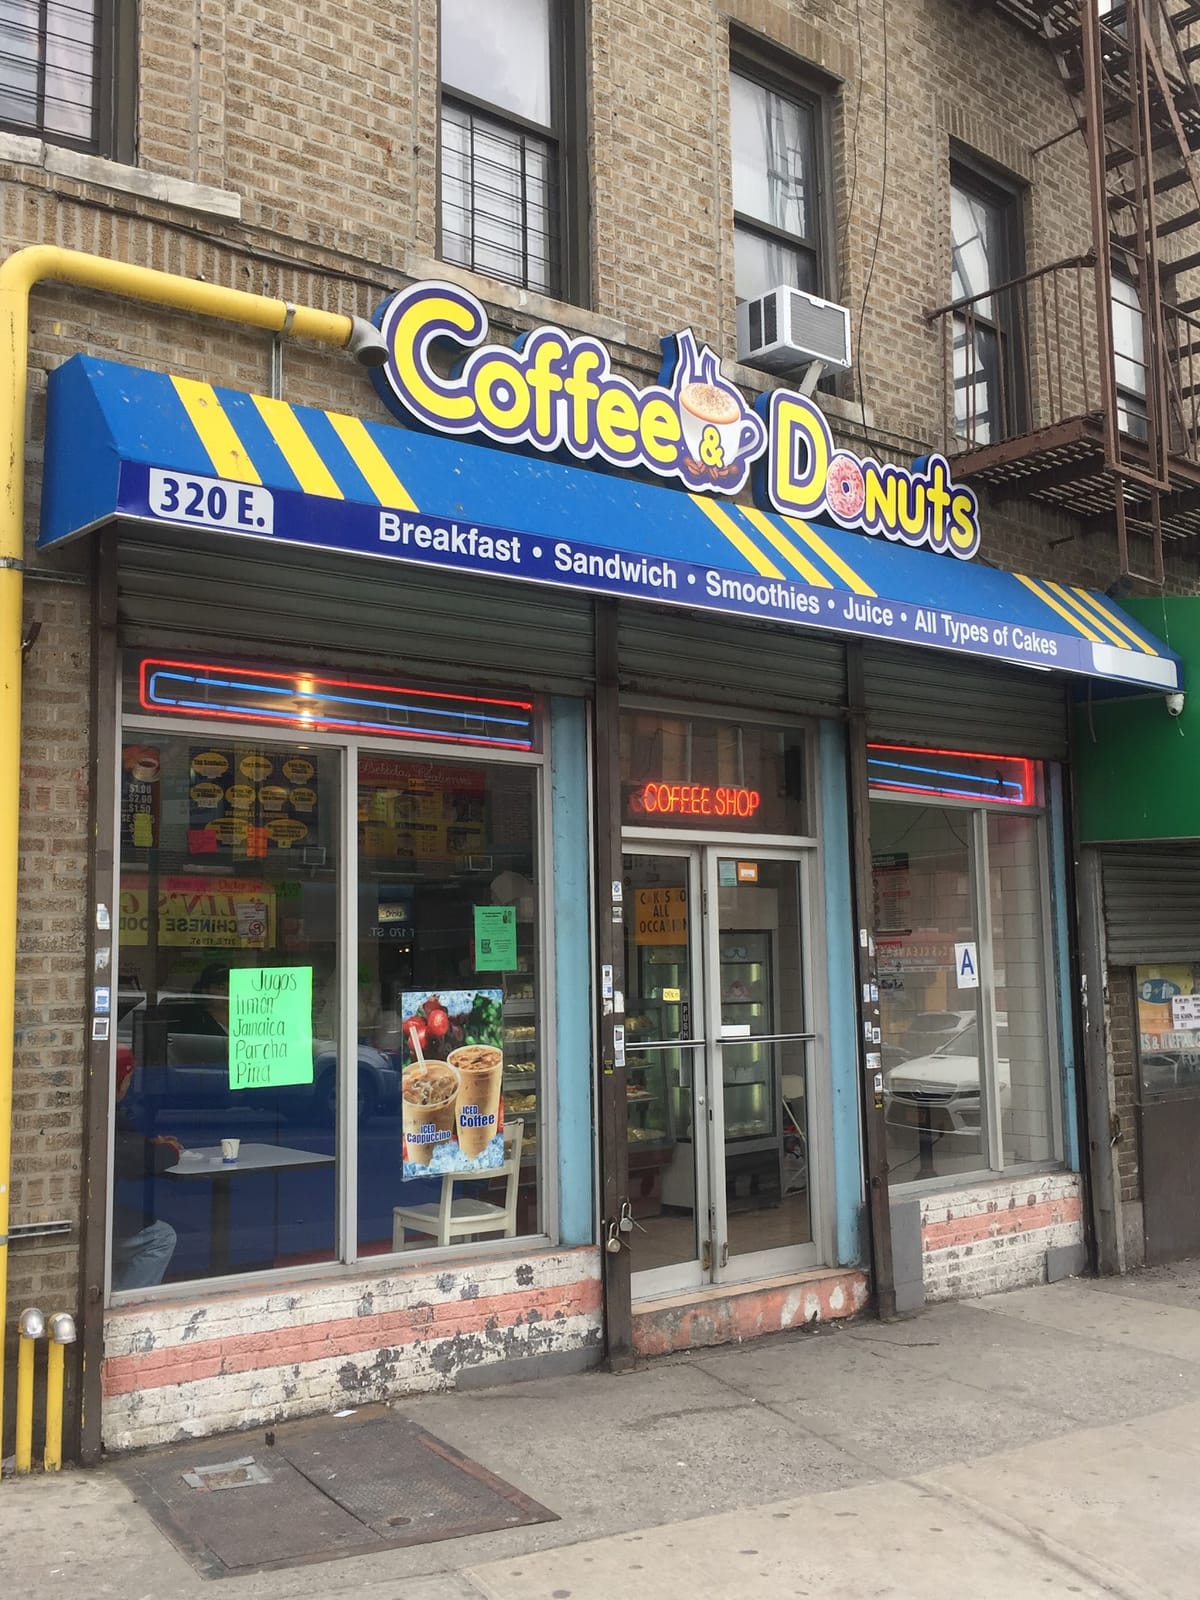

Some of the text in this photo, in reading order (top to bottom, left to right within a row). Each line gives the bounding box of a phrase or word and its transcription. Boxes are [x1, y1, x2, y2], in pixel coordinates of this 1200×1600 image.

[391, 295, 682, 465] Coffee
[697, 425, 724, 468] &
[159, 477, 266, 528] 320 E.
[378, 510, 1059, 656] Breakfast Sandwich Smoothies Juice All Types of Cakes
[643, 782, 760, 817] COFFEE SHOP
[640, 890, 671, 905] CKS
[653, 904, 670, 918] ALL
[960, 948, 975, 976] A
[251, 969, 297, 999] Jugos
[232, 1017, 286, 1038] Jamaica
[235, 1039, 288, 1060] Parcha
[460, 1113, 495, 1128] Coffee
[406, 1129, 452, 1145] Cappuccino
